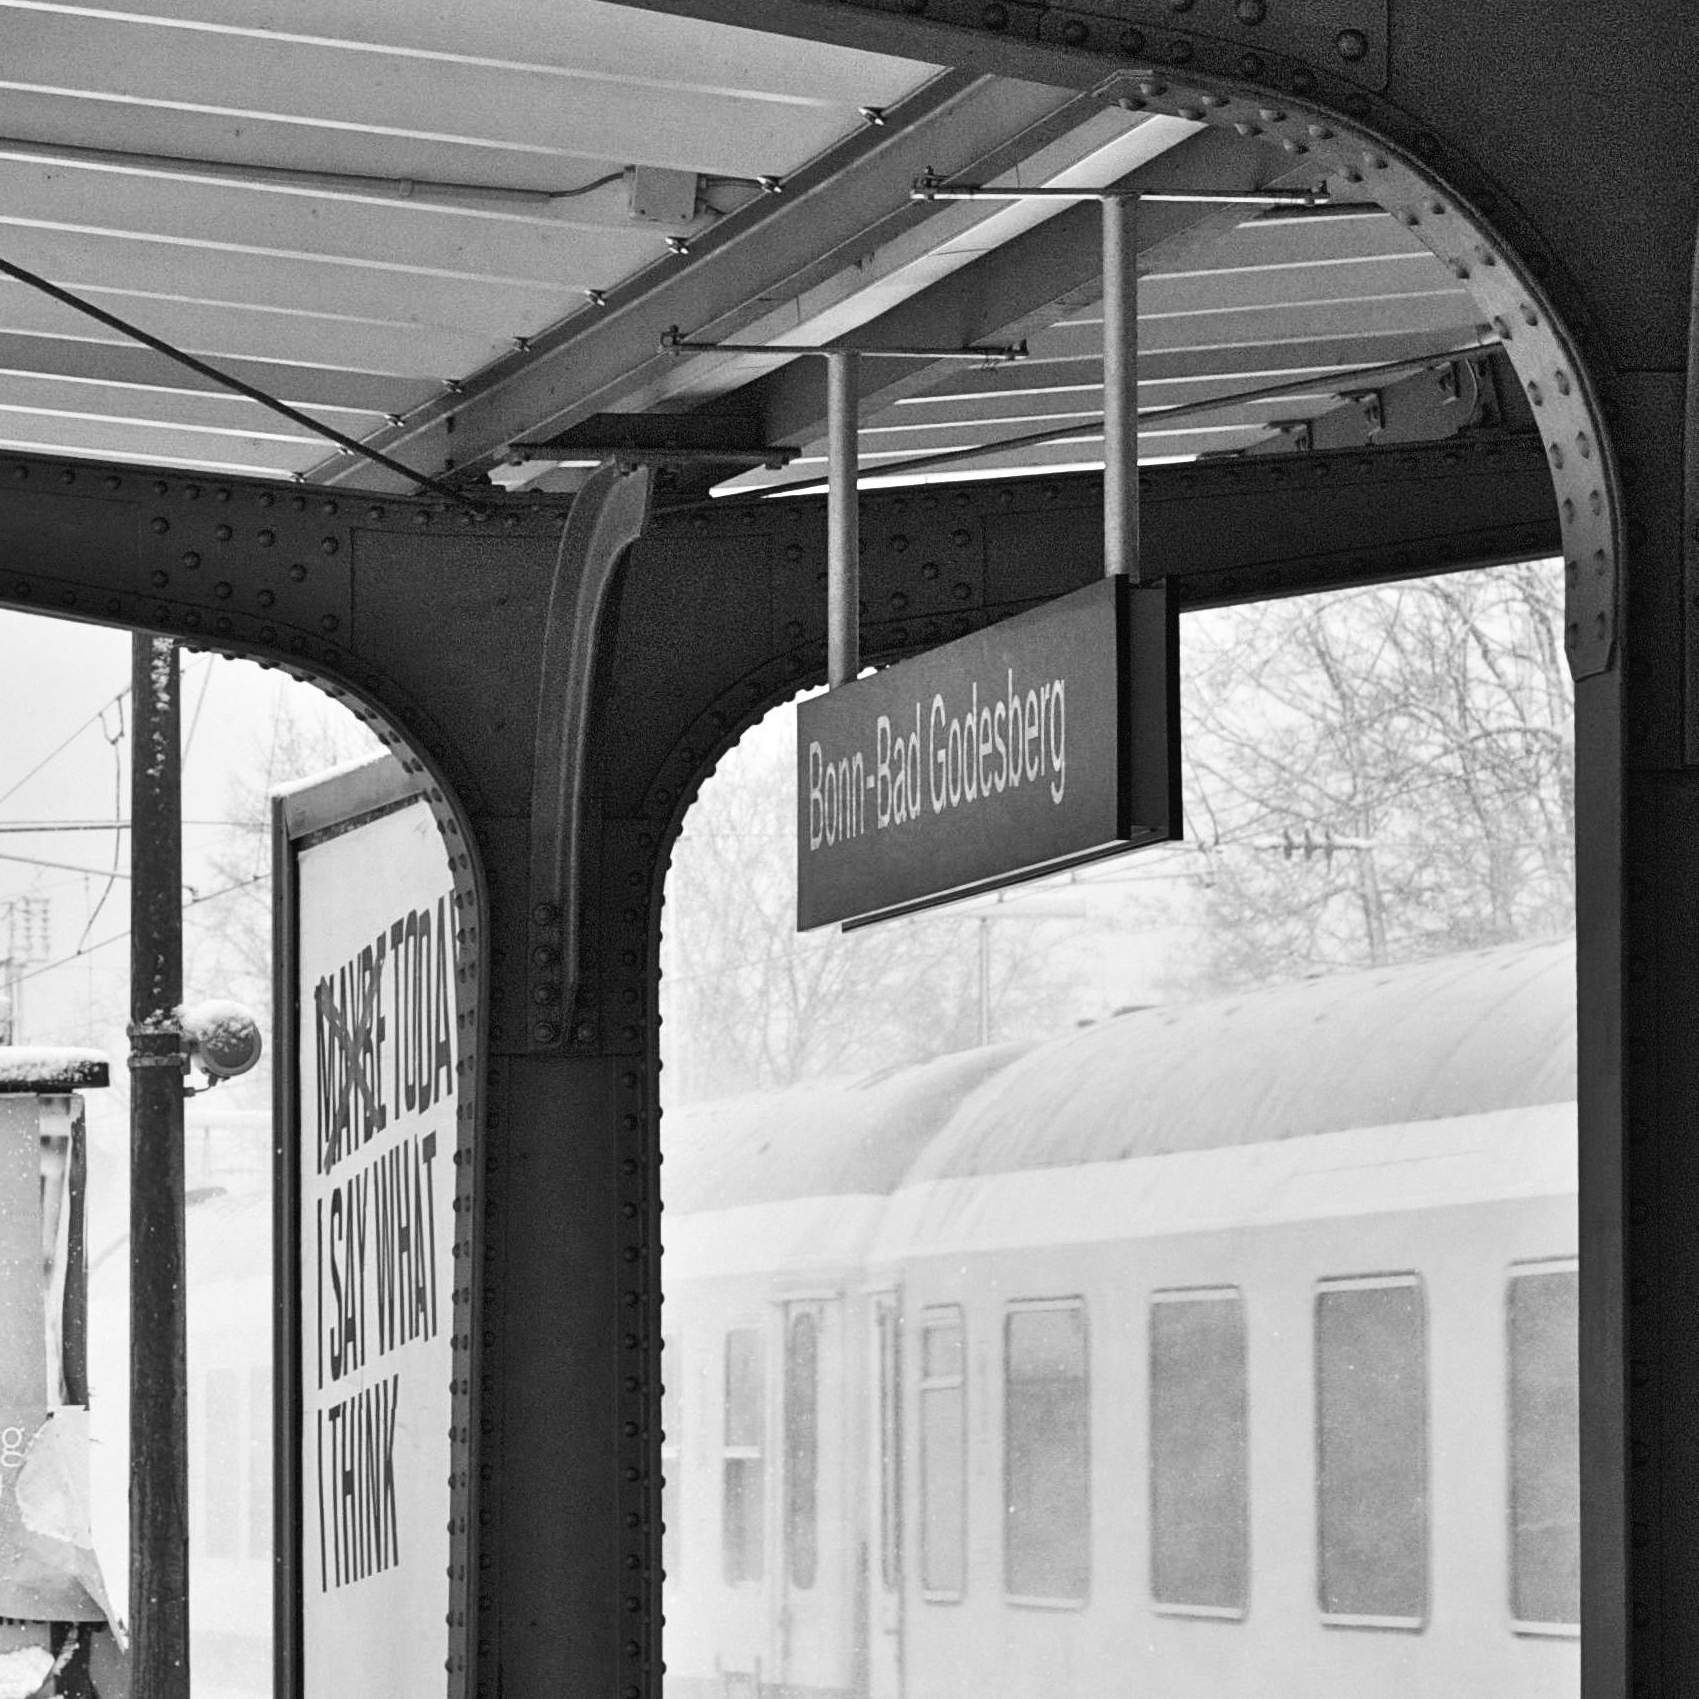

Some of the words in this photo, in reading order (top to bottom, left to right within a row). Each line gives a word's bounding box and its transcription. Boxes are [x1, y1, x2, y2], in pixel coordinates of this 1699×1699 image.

[809, 701, 922, 851] Bonn-Bad
[929, 667, 1066, 814] Godesberg
[390, 889, 457, 1121] TODA
[317, 1197, 323, 1391] I
[329, 1166, 369, 1382] SAY
[373, 1129, 437, 1357] WHAT
[318, 1409, 327, 1594] I
[328, 1372, 399, 1589] THINK
